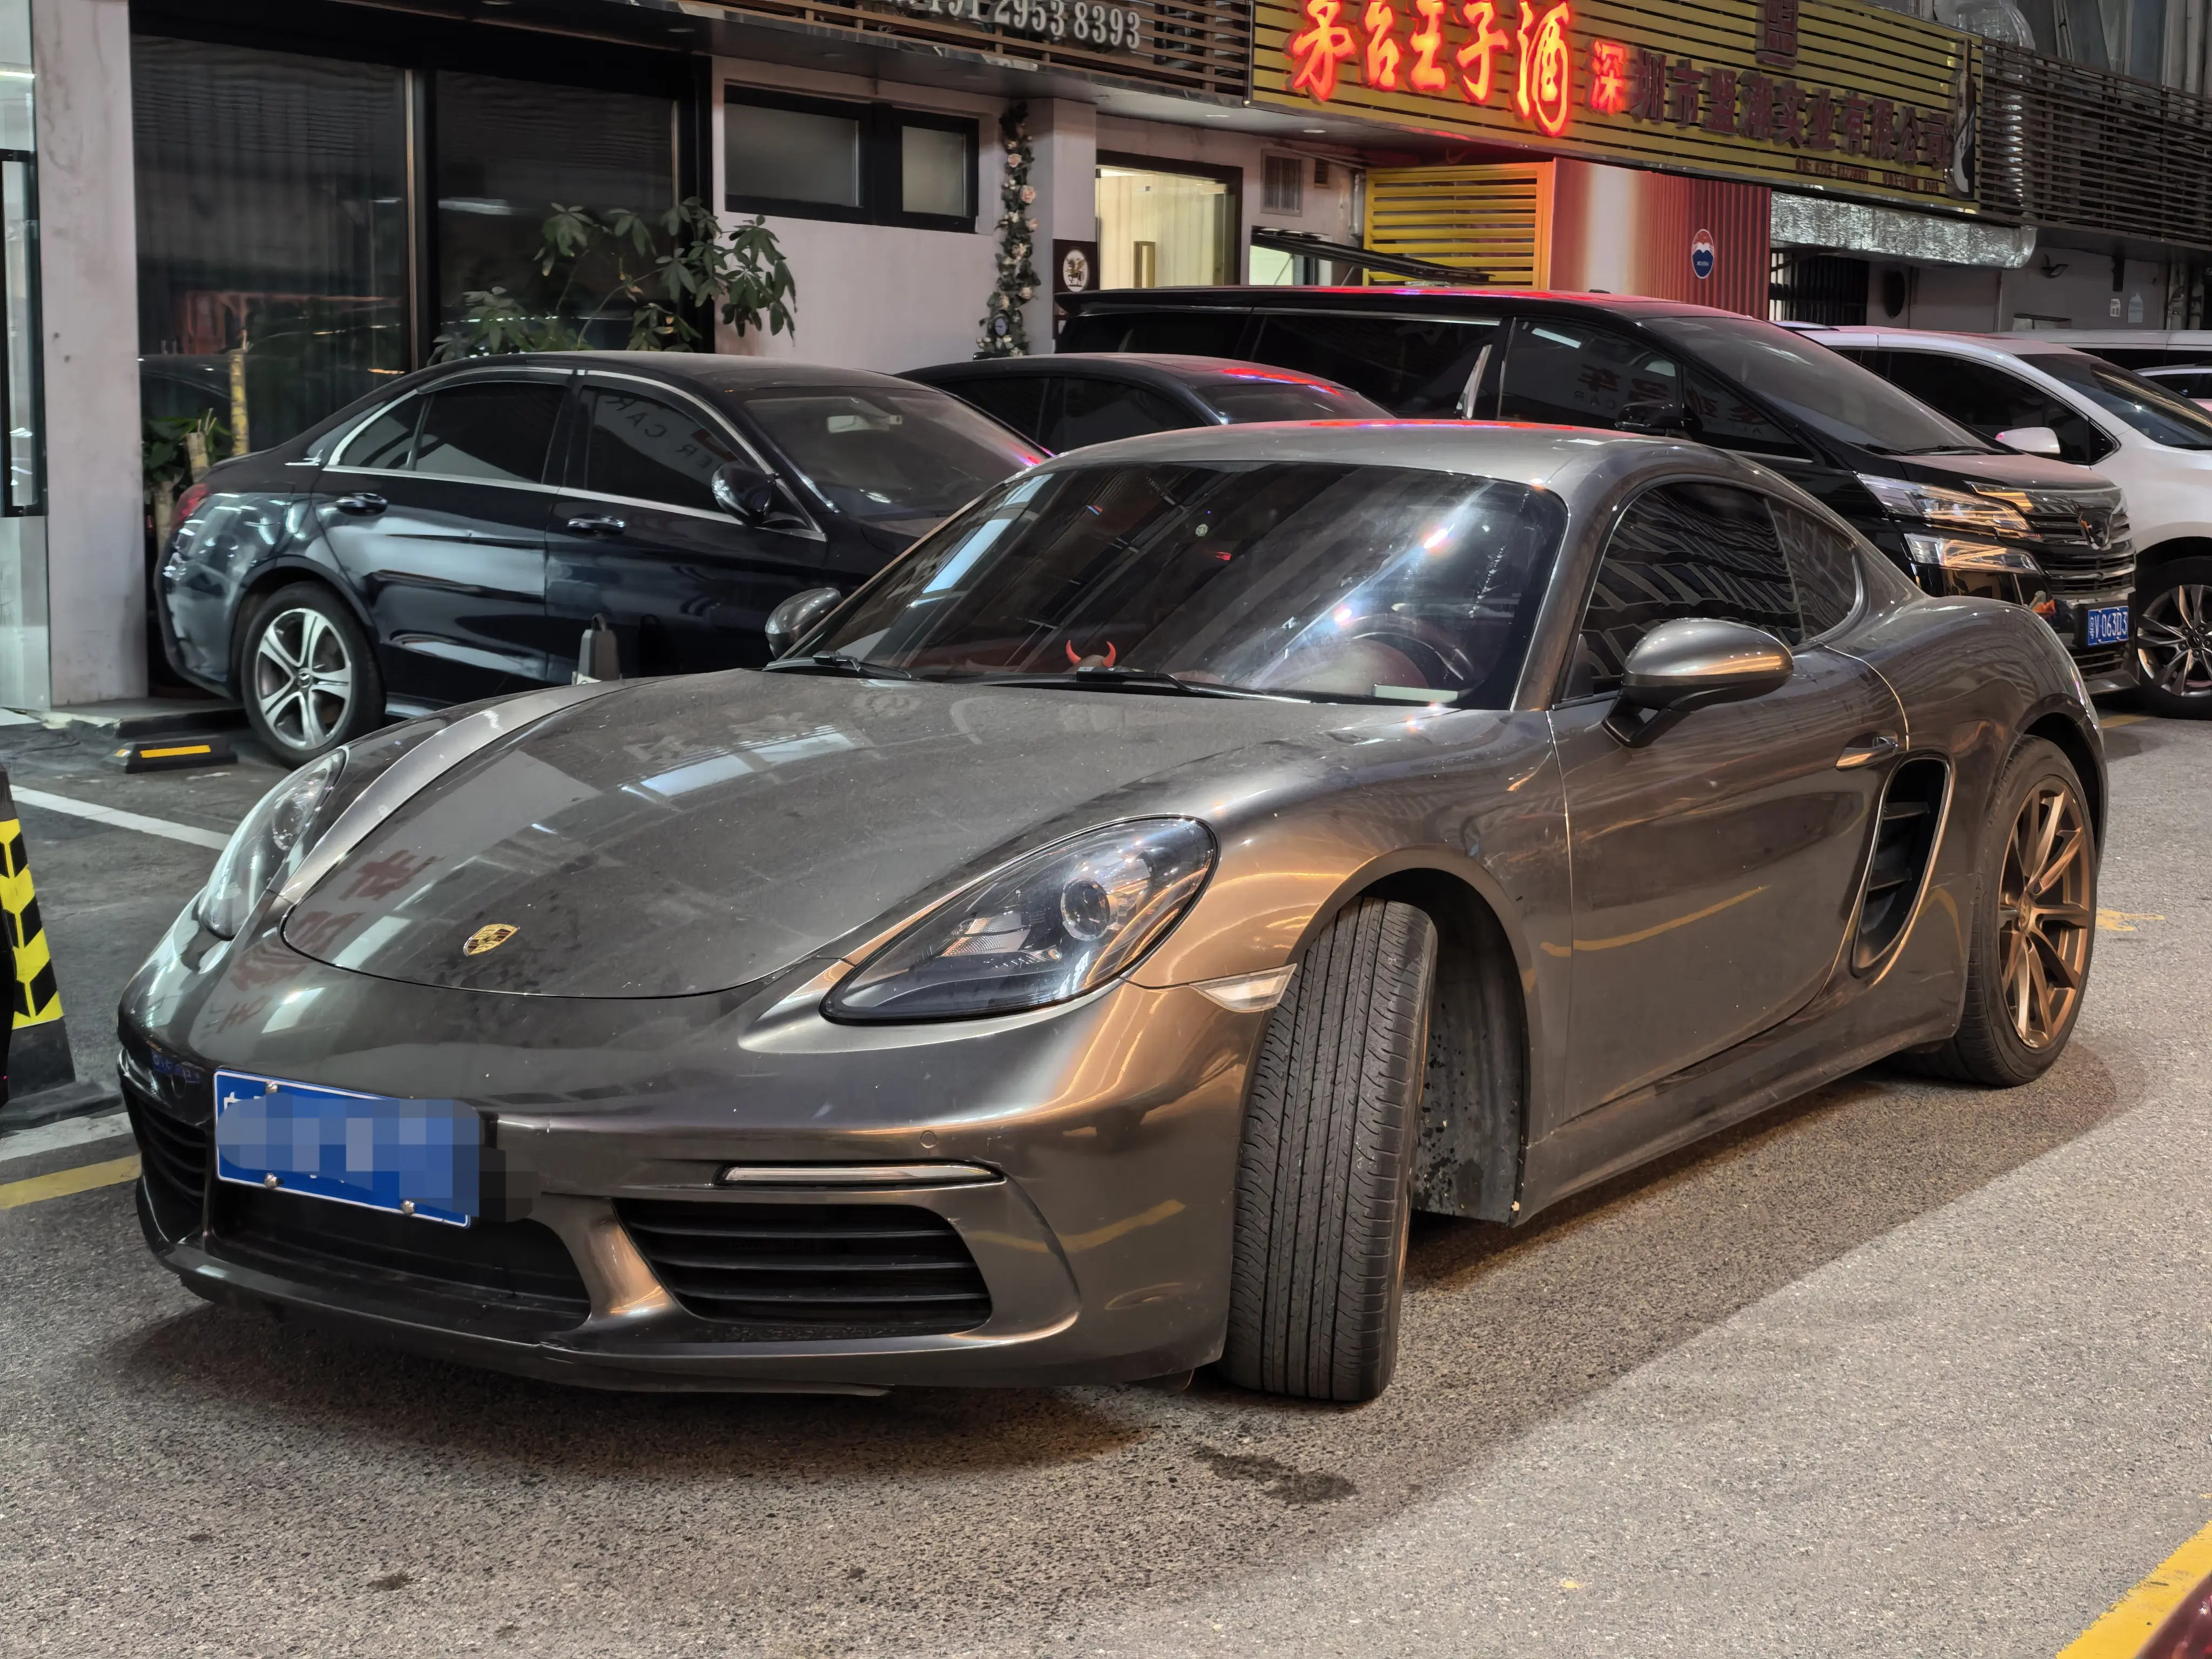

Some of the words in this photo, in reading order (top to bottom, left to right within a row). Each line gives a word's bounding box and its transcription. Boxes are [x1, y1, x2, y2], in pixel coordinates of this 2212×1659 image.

[994, 0, 1065, 36] 2953
[1074, 2, 1141, 49] 8393
[1291, 0, 1571, 136] 茅台王子酒
